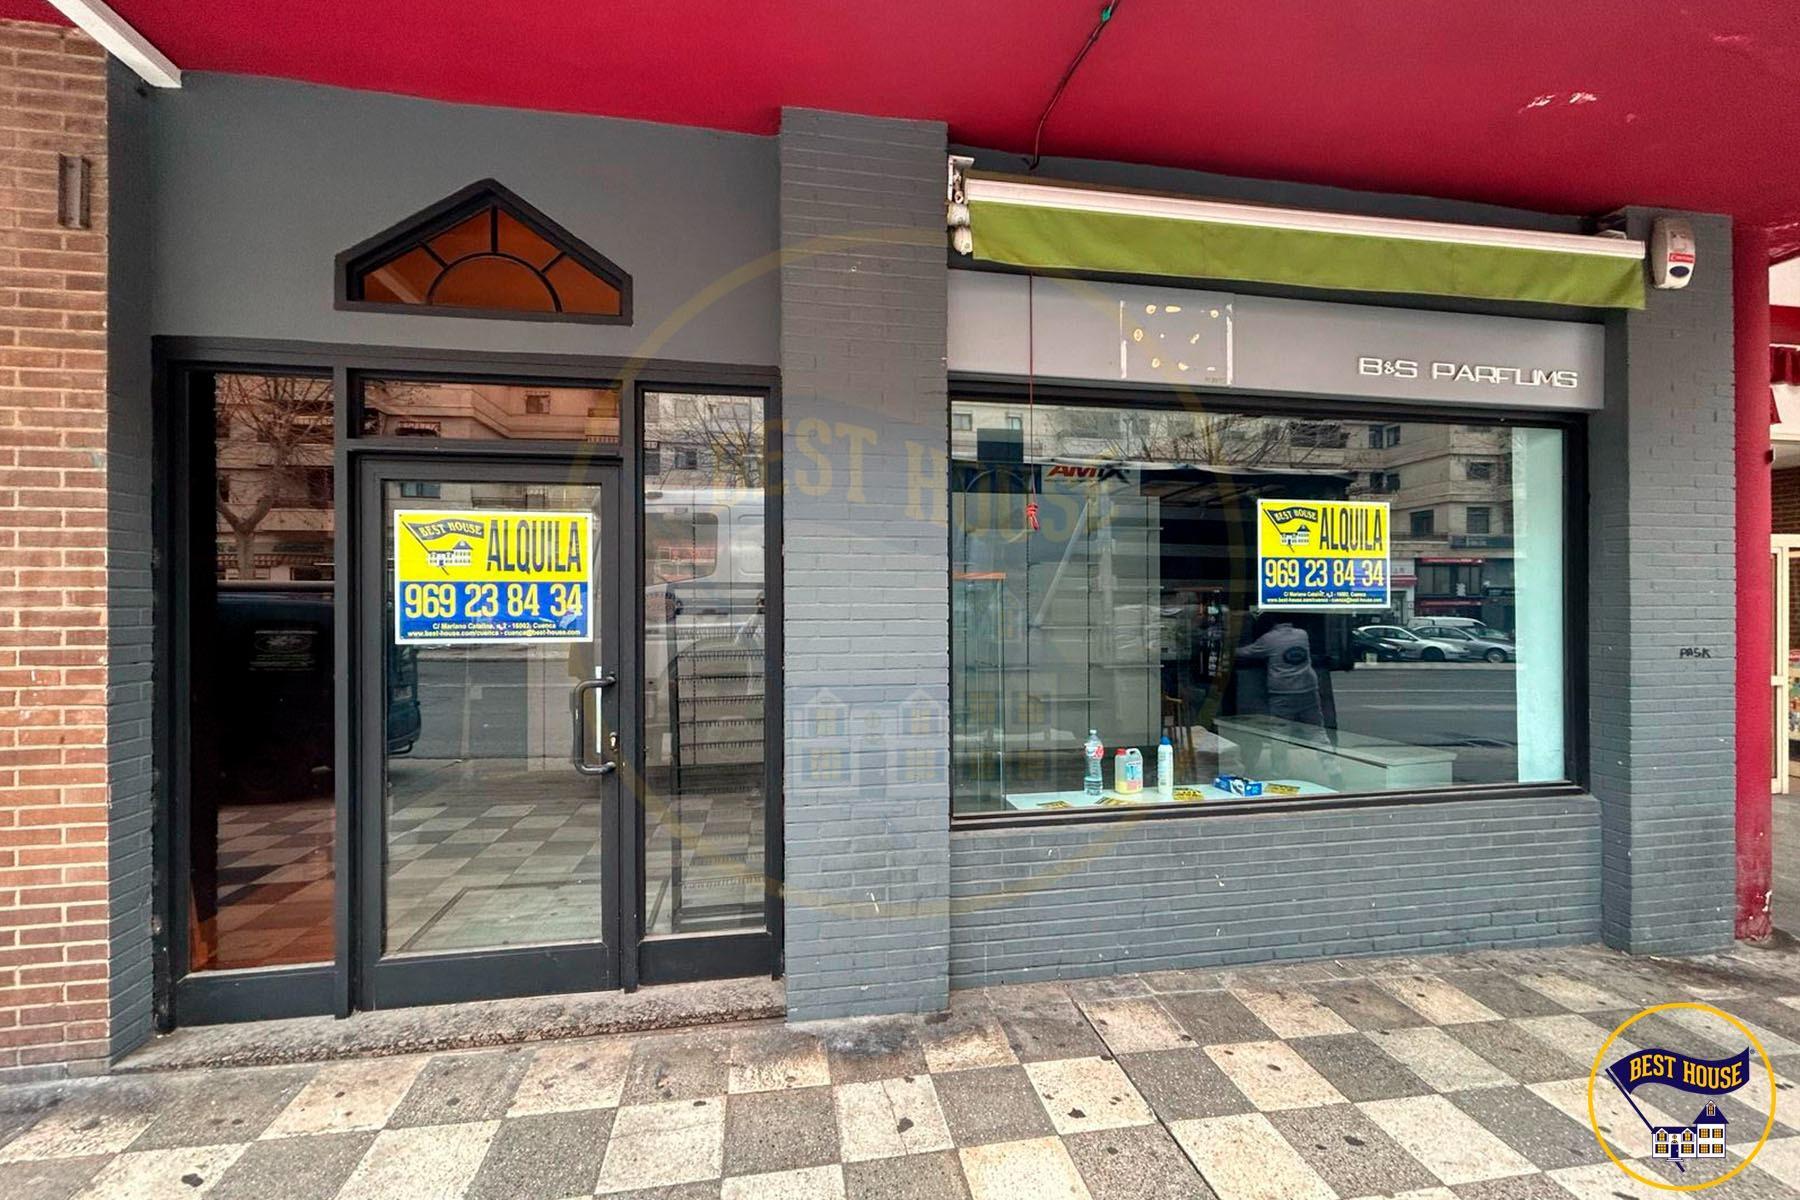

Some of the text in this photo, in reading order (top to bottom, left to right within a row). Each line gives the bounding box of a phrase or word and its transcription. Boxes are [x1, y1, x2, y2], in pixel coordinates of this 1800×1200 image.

[1359, 357, 1578, 388] B&S PARFUMS
[418, 521, 483, 537] BEST HOUSE
[1273, 508, 1318, 522] BEST HOUSE
[1319, 507, 1383, 552] ALQUILA
[486, 519, 582, 574] ALQUILA
[1265, 558, 1384, 588] 969 23 84 34
[404, 583, 583, 618] 969 23 84 34
